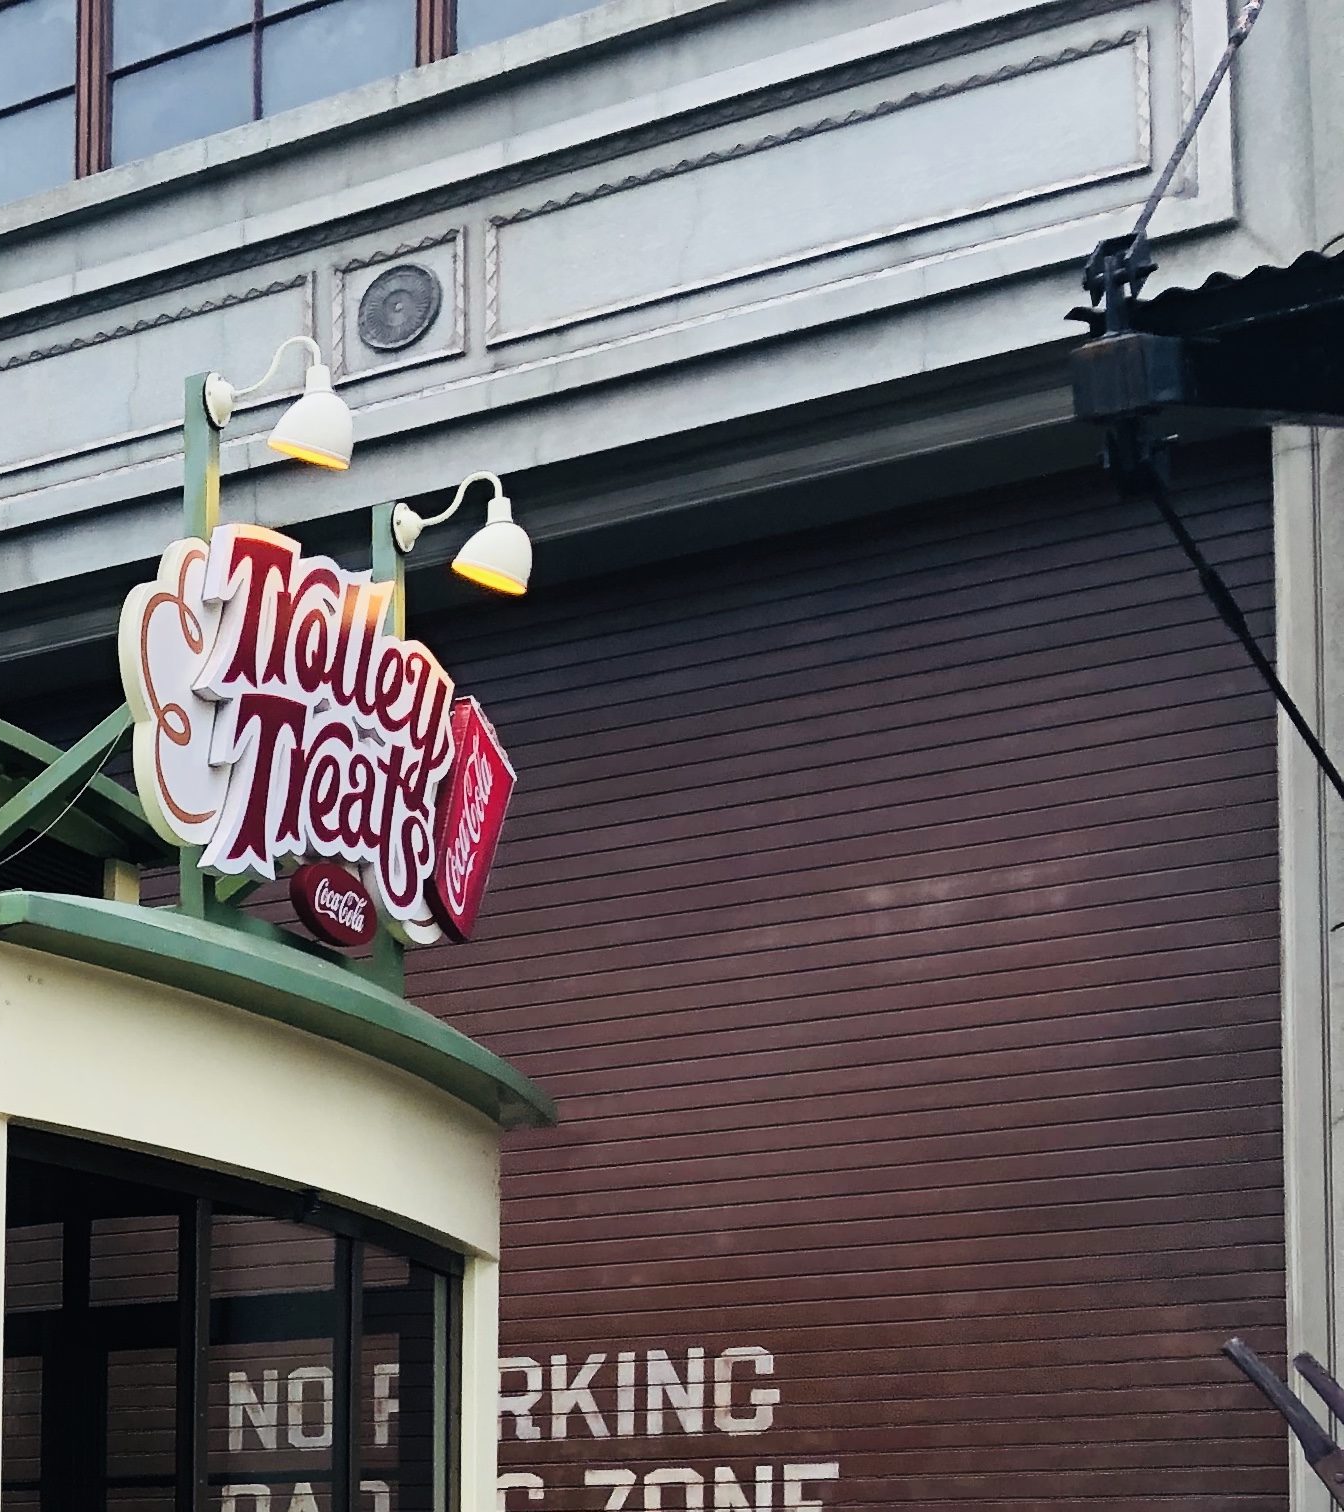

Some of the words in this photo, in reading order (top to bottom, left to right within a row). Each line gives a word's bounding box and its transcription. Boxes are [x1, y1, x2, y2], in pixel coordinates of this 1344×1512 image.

[222, 537, 451, 796] Trolley
[226, 694, 430, 907] Treats
[228, 1366, 333, 1451] NO
[373, 1346, 782, 1448] PRKING
